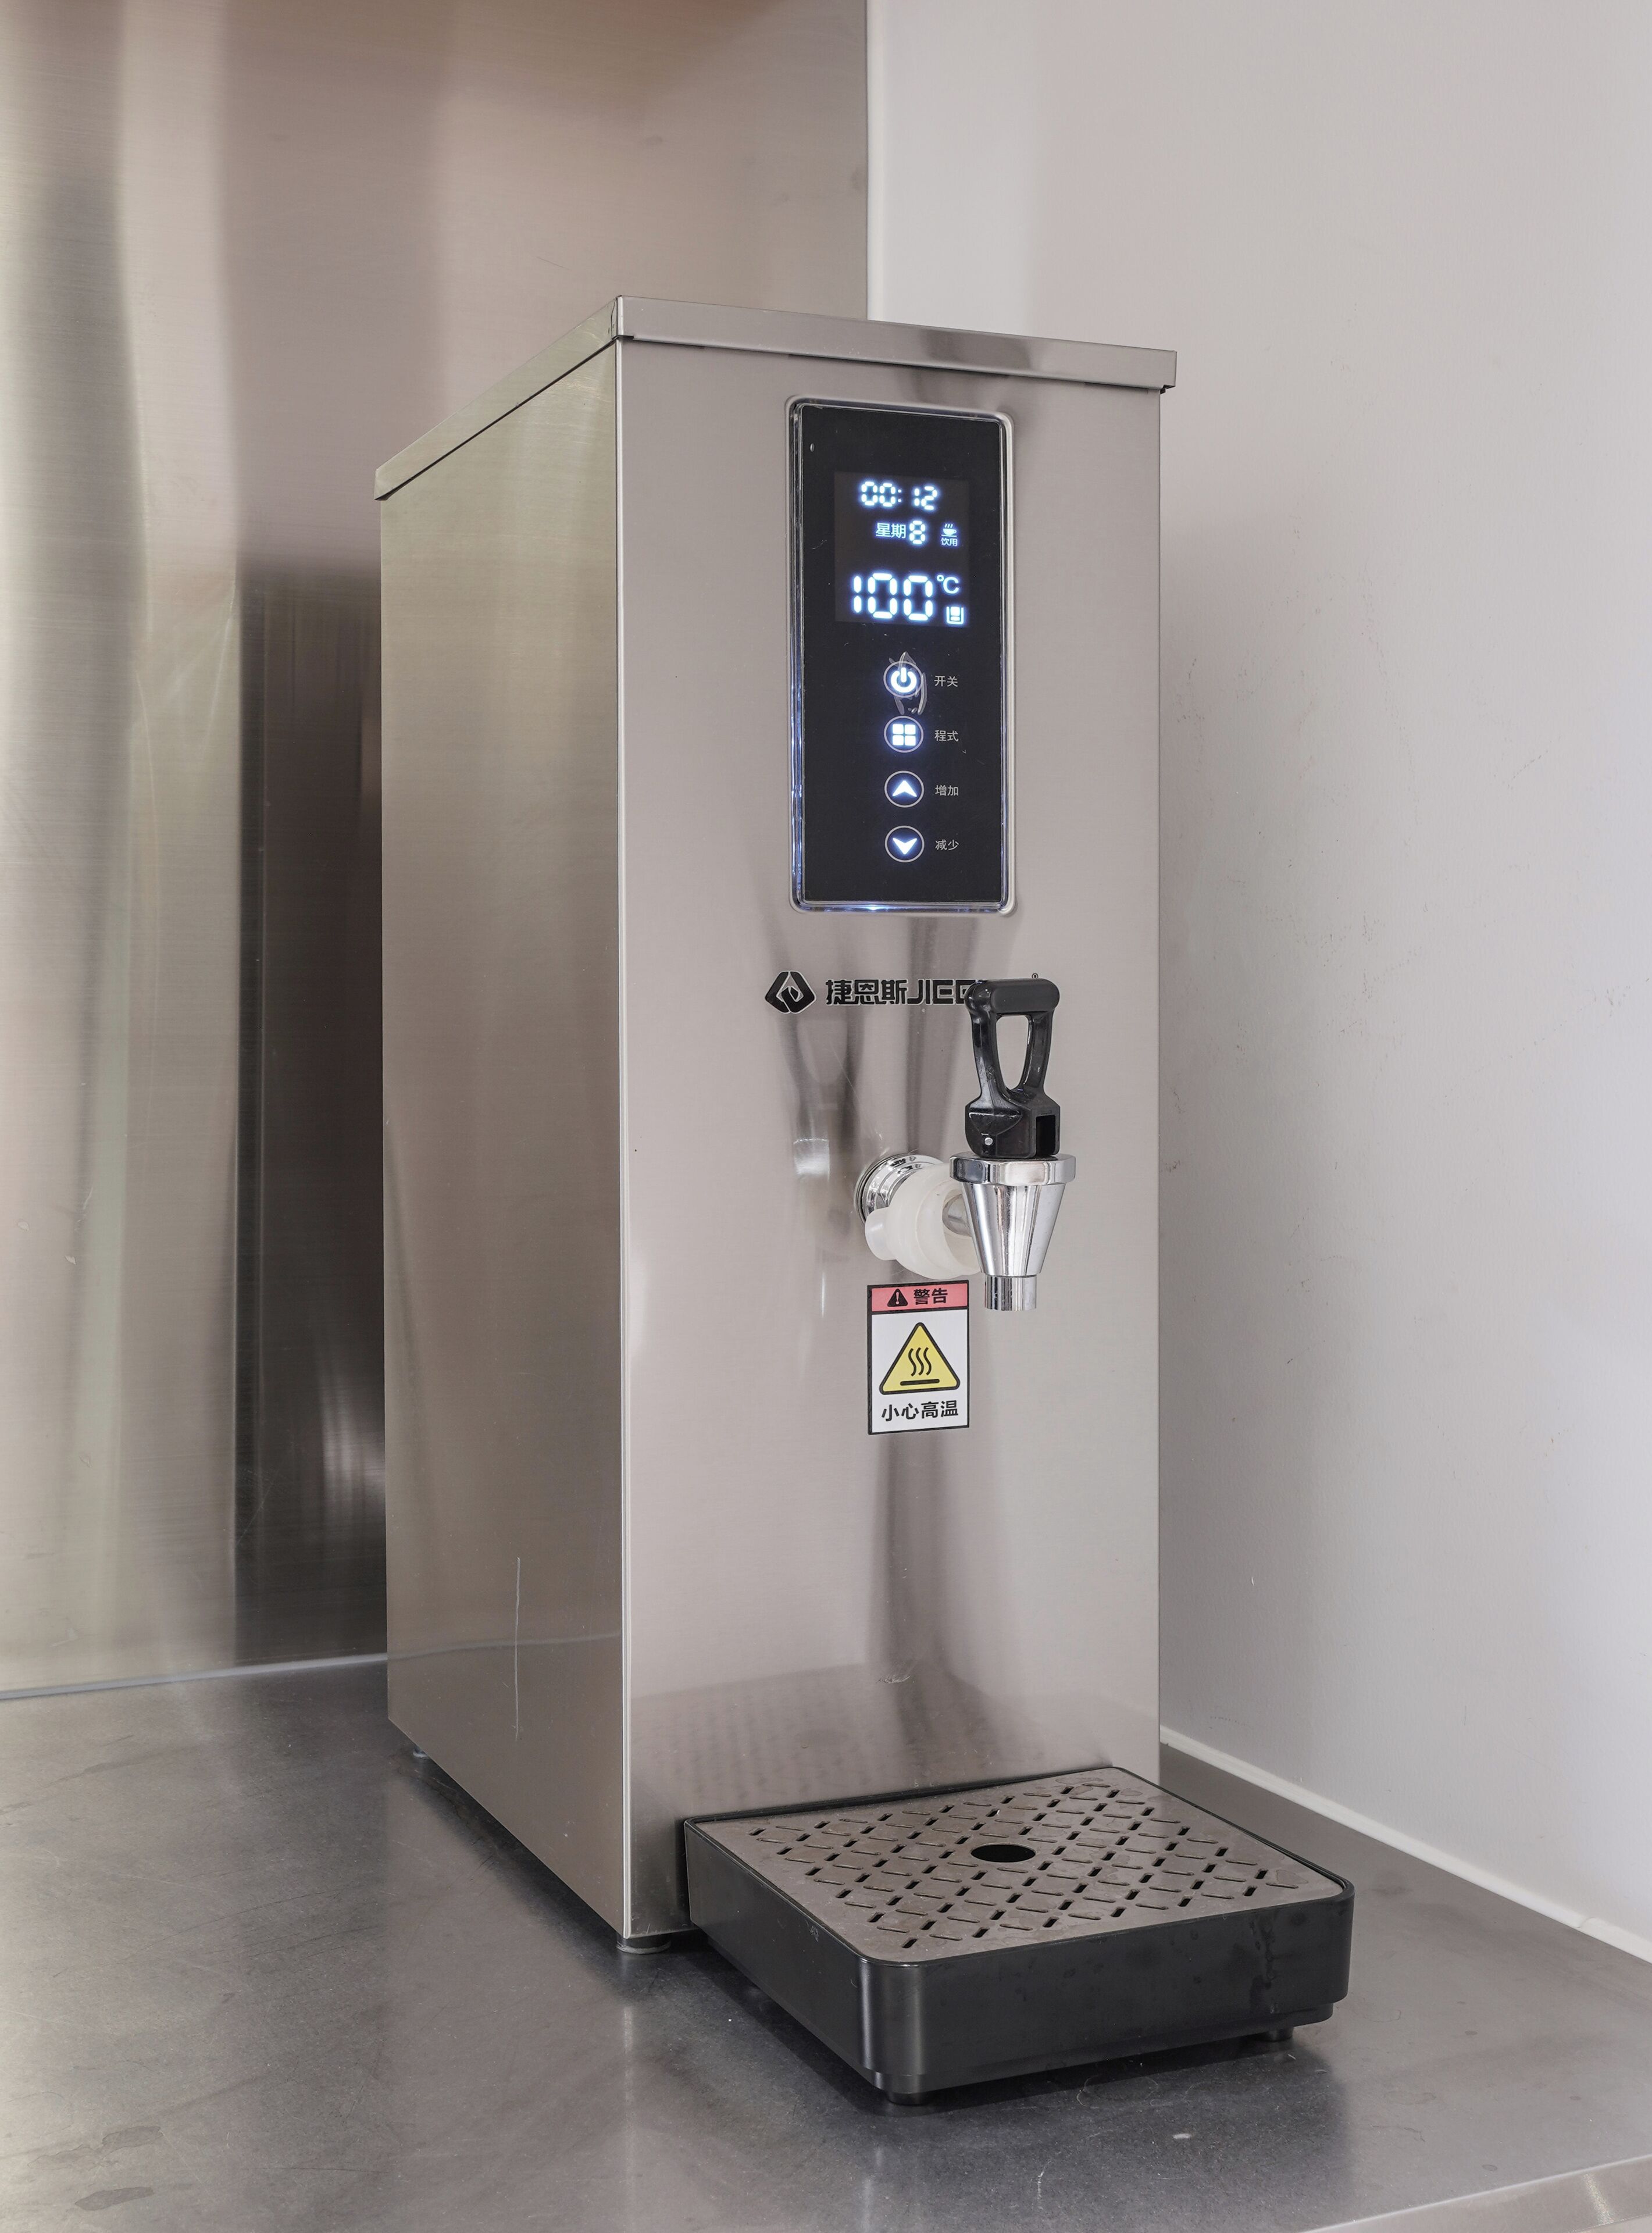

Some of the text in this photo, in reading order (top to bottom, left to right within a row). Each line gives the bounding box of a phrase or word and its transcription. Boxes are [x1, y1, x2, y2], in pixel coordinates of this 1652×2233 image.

[861, 480, 939, 511] 00:12
[940, 537, 958, 547] 饮用
[934, 675, 958, 687] 开关
[934, 729, 959, 742] 程式
[934, 784, 959, 797] 增加
[934, 839, 959, 851] 减少
[914, 1288, 948, 1305] 警告
[881, 1400, 958, 1422] 小心高温
